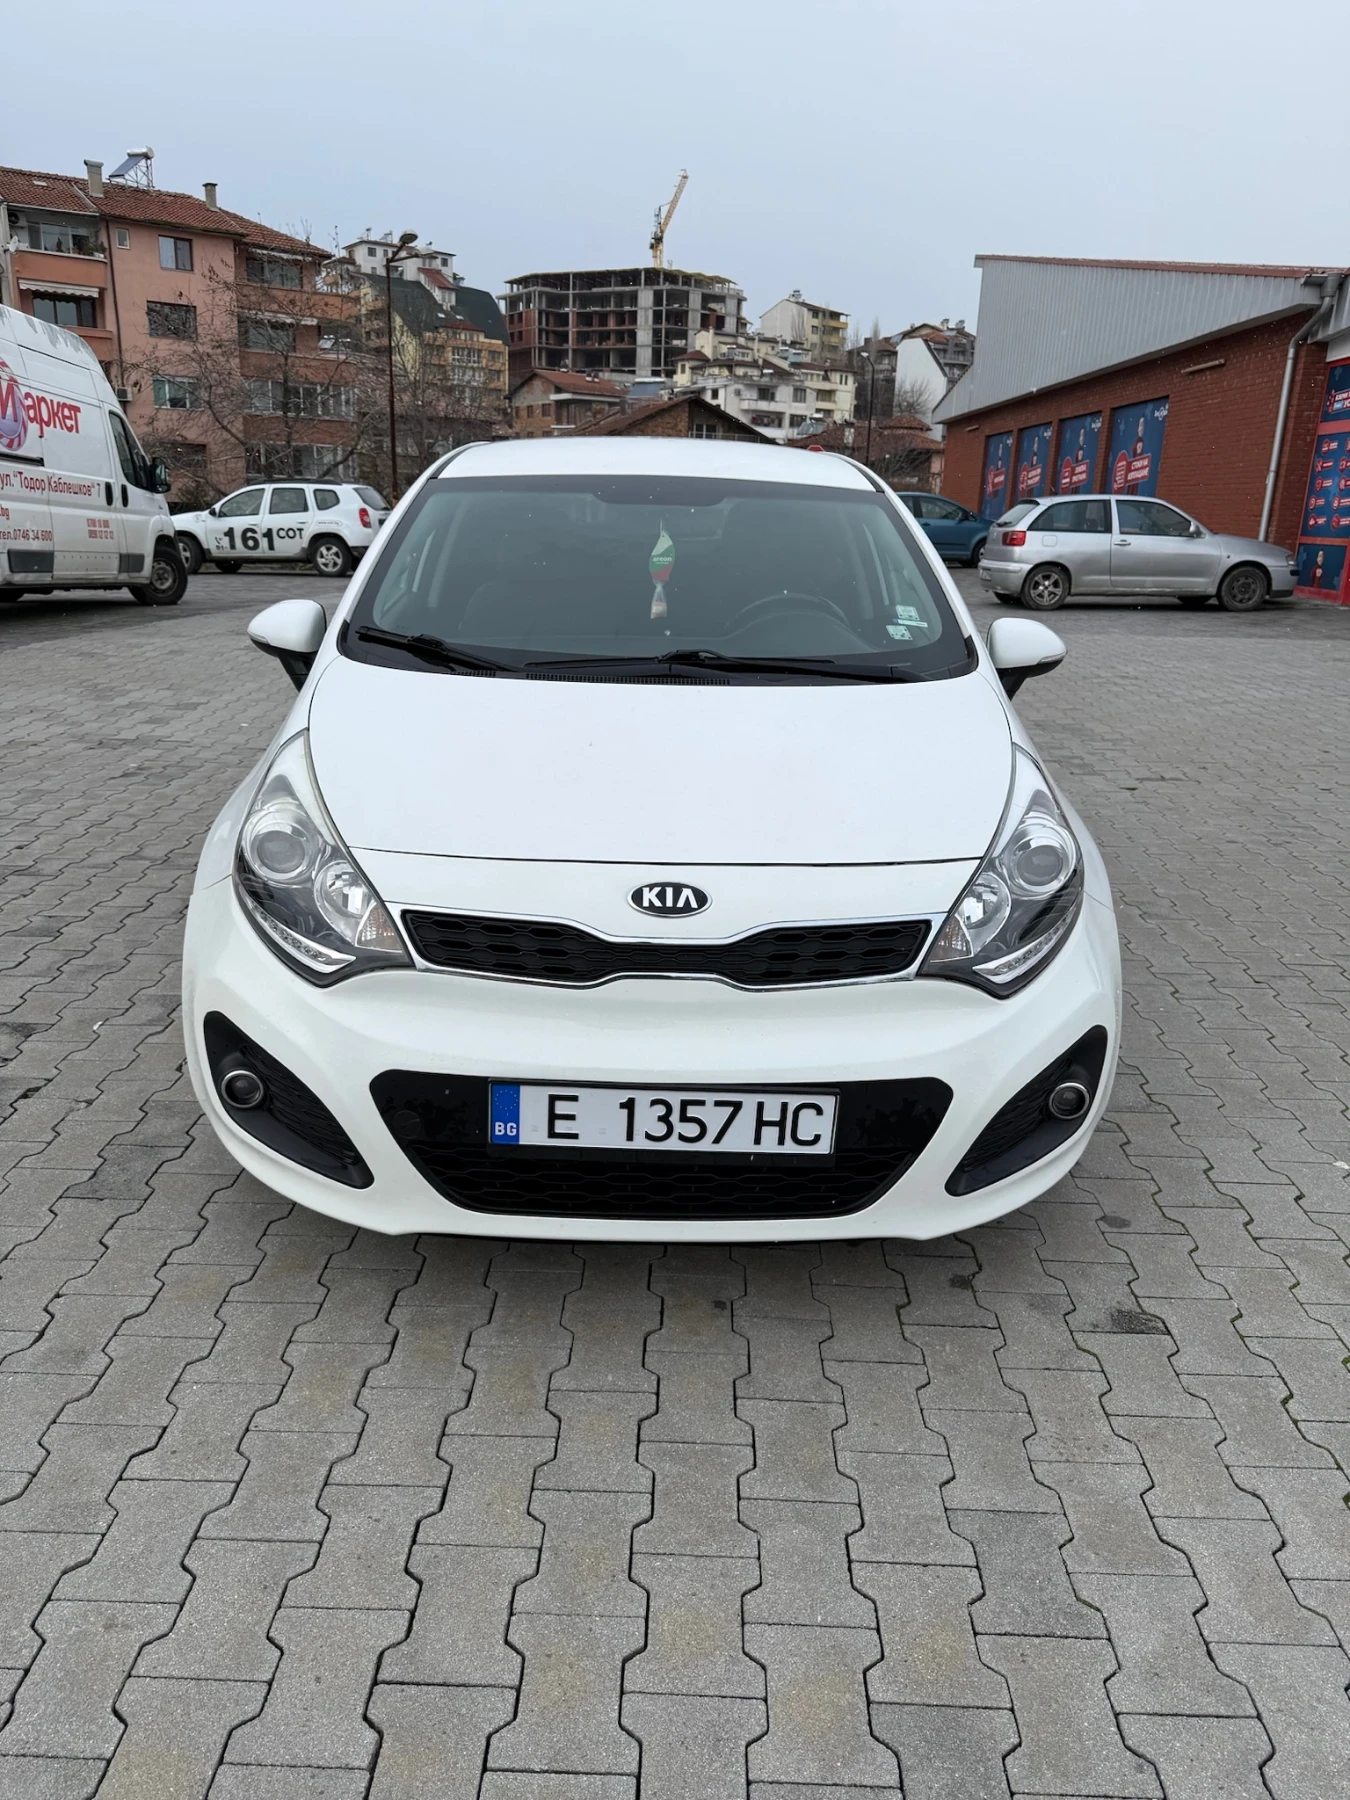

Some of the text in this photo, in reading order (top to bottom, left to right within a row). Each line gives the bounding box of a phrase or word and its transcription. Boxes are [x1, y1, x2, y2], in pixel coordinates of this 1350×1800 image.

[223, 527, 275, 551] 161
[642, 886, 699, 909] KIA
[494, 1122, 517, 1136] BG
[547, 1093, 824, 1147] E 1357 HC
